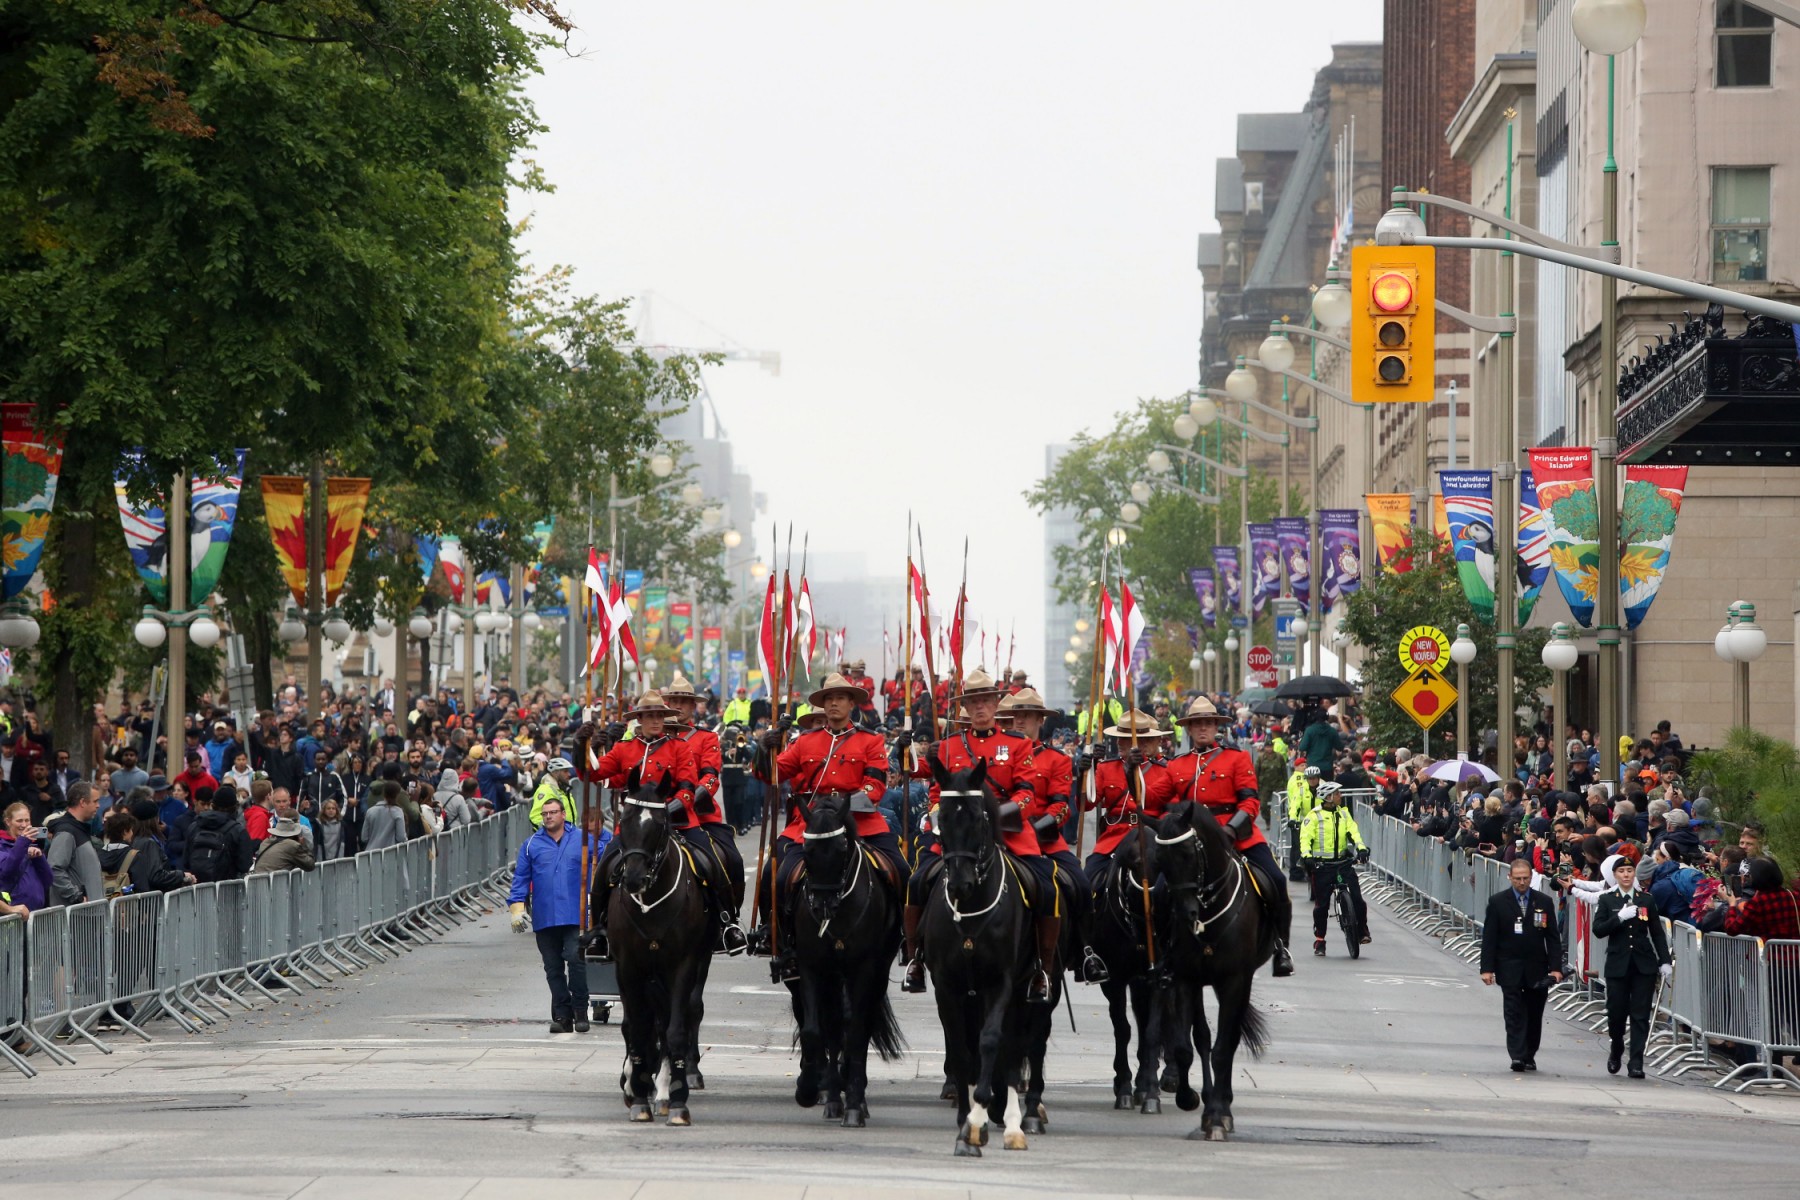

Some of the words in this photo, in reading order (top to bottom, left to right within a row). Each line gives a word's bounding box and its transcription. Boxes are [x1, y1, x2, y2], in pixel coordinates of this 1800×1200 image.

[1559, 454, 1588, 462] Edward
[1416, 640, 1432, 650] NEW
[1248, 653, 1272, 665] STOP
[1413, 651, 1437, 661] NOUVEAU
